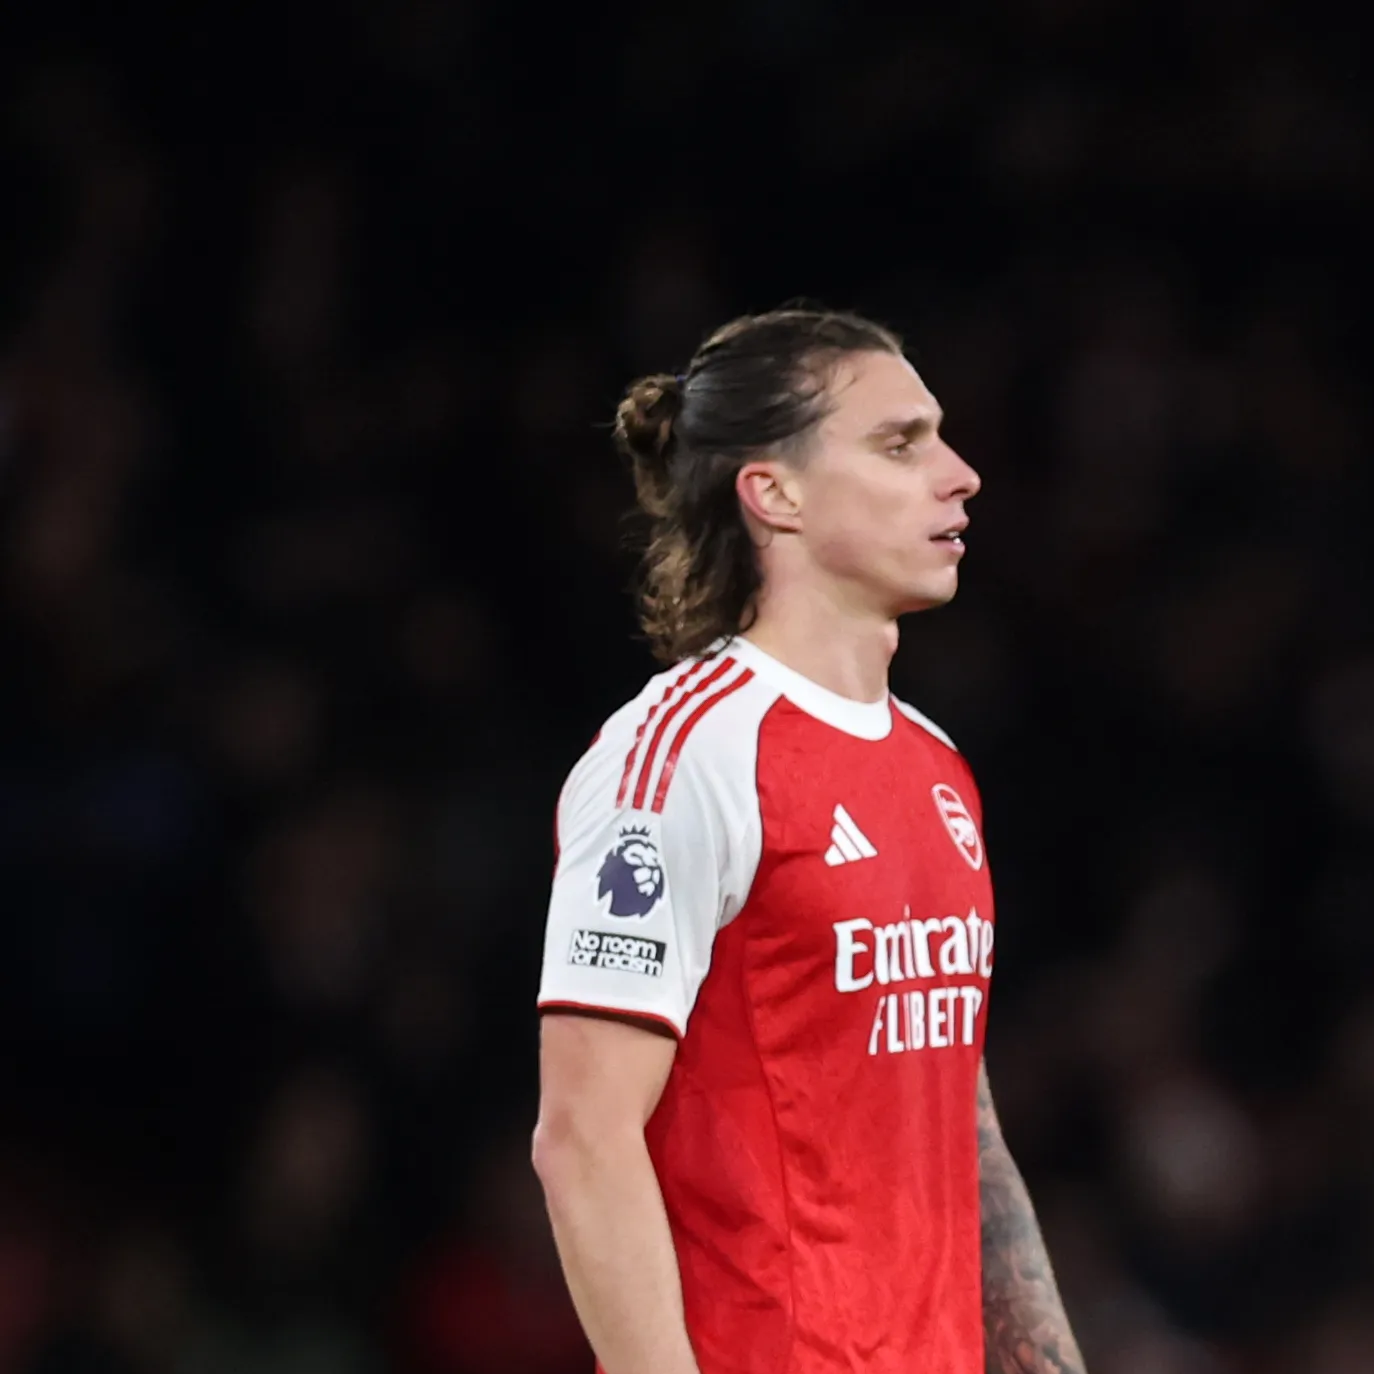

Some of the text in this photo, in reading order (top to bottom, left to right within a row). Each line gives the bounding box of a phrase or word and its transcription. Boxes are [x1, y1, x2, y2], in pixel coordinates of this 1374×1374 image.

[572, 930, 657, 960] No room
[832, 904, 994, 993] Emirate
